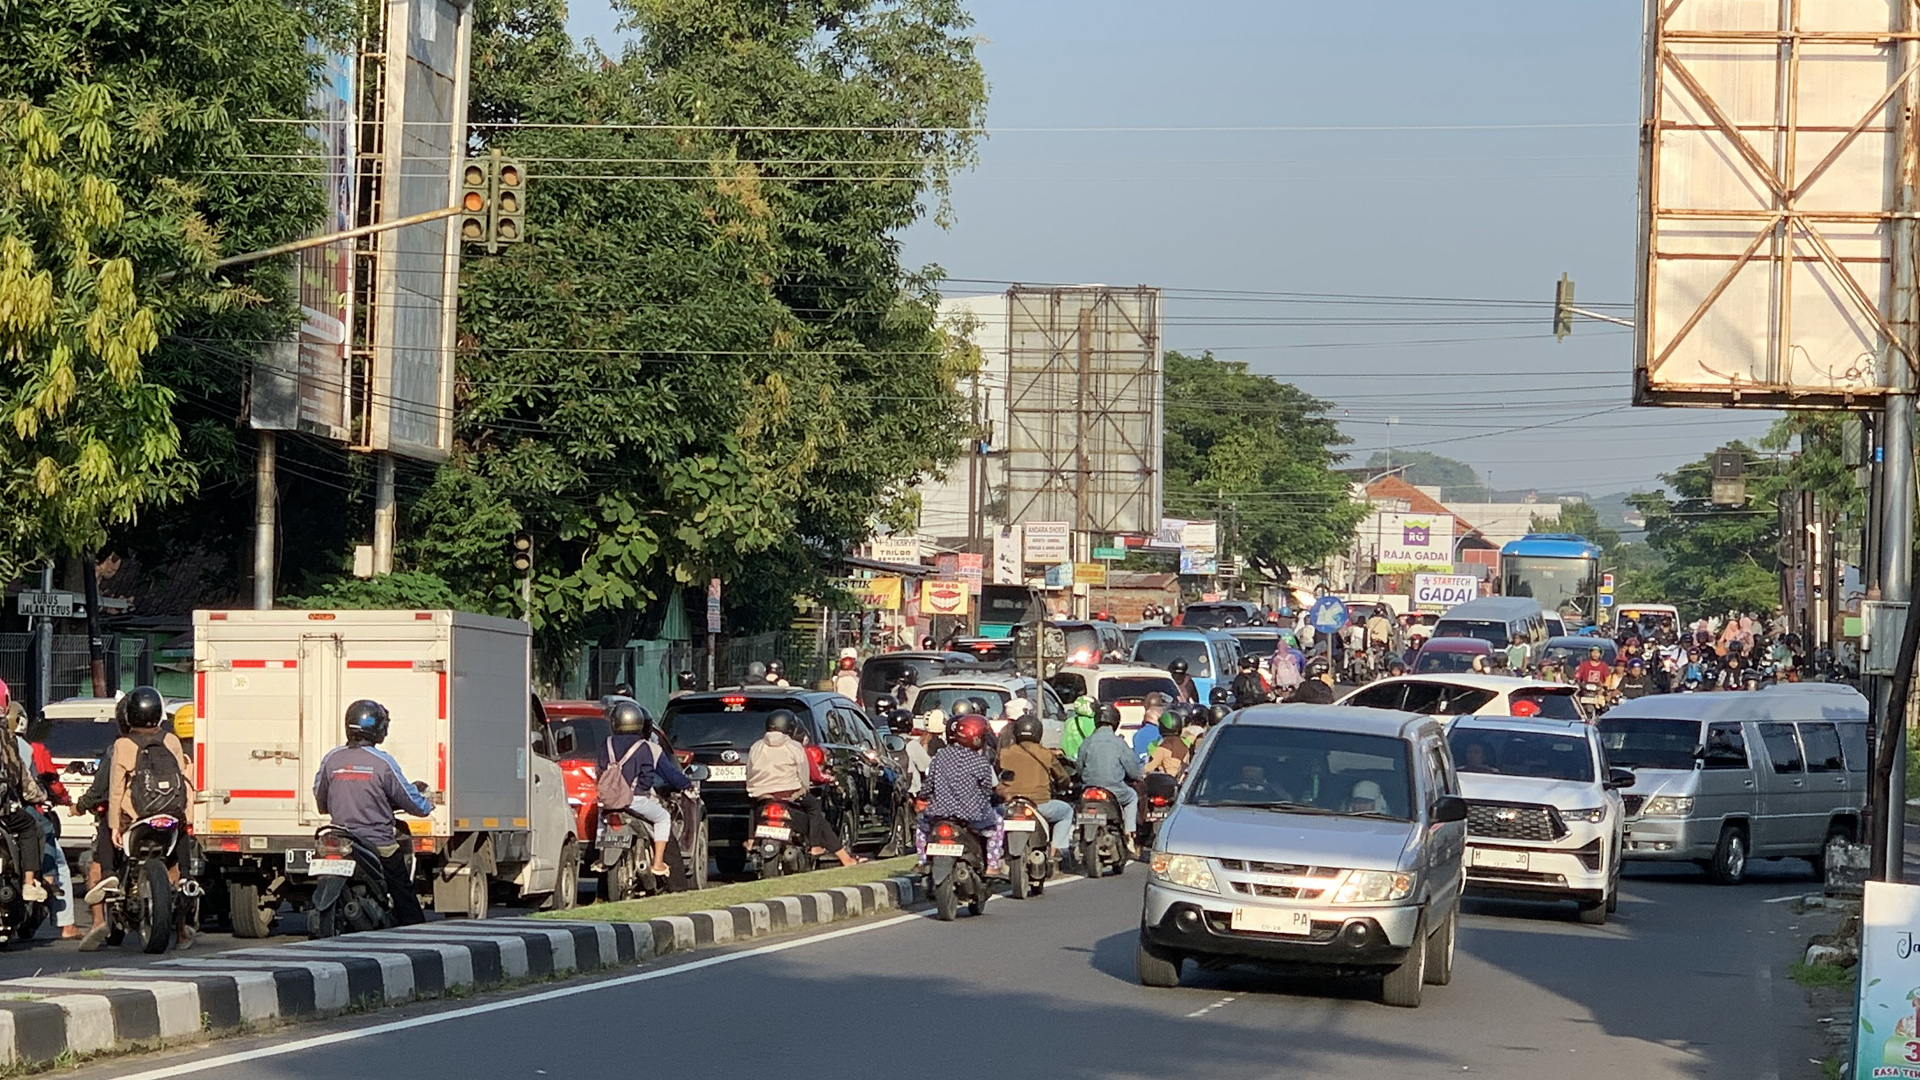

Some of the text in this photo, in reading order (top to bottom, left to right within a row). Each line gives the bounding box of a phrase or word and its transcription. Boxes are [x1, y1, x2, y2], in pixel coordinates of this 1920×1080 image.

[1408, 532, 1425, 541] RG
[1383, 550, 1448, 561] RAJA GADAI
[1432, 577, 1471, 586] STARTECH
[33, 594, 58, 605] LURUS
[1419, 587, 1472, 602] GADAI
[20, 604, 70, 615] JALAN TERUS
[1235, 907, 1308, 927] H PA
[1873, 1068, 1900, 1078] RASA
